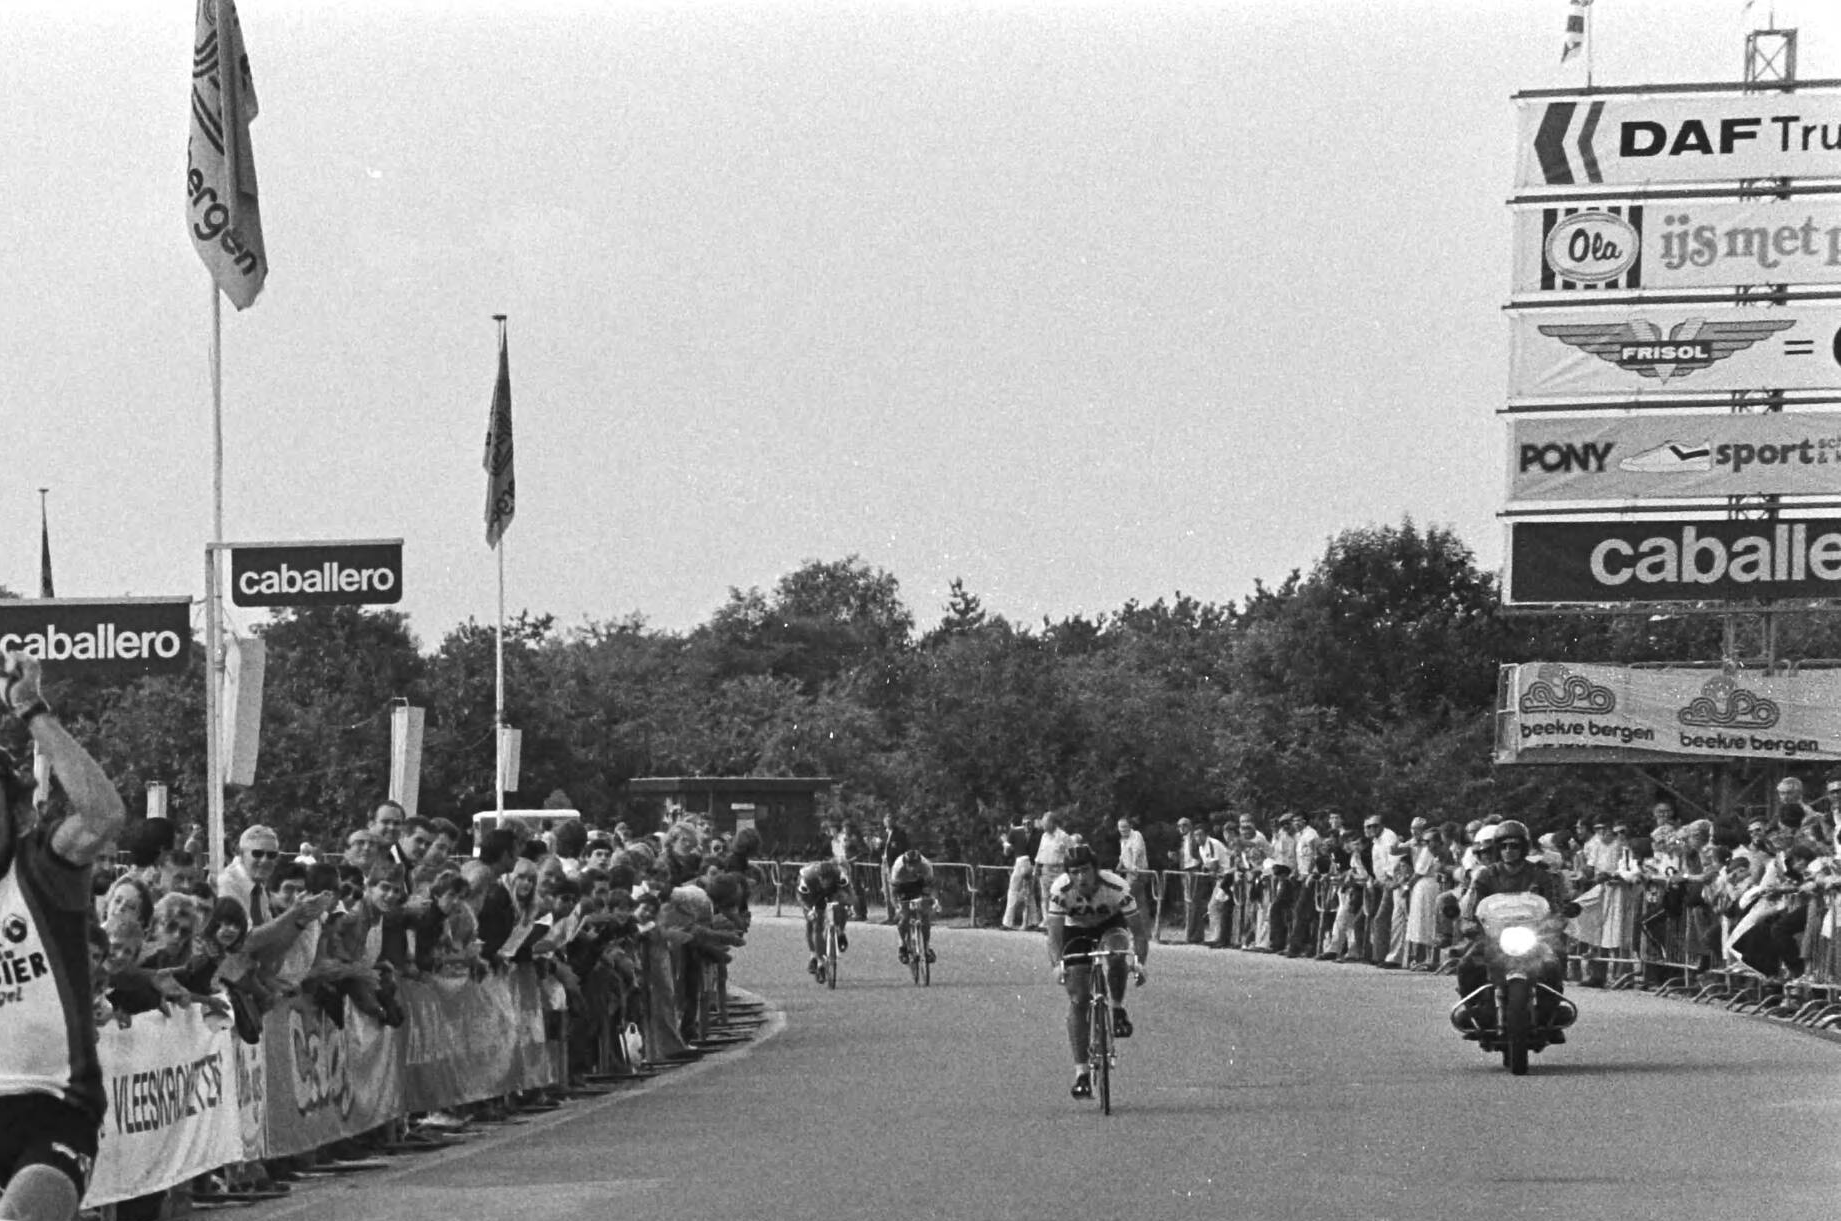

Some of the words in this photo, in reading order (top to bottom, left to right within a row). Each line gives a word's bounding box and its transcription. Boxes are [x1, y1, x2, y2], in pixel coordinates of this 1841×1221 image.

[1619, 117, 1761, 157] DAF
[187, 162, 257, 277] ergen
[1568, 227, 1623, 263] Ola
[1621, 345, 1709, 361] FRISOL
[1520, 442, 1614, 473] PONY
[1716, 438, 1815, 473] sport
[1590, 523, 1841, 586] caballe
[239, 562, 394, 595] caballero
[0, 623, 181, 661] caballero
[1588, 722, 1656, 744] bergen
[1750, 735, 1820, 756] bergen
